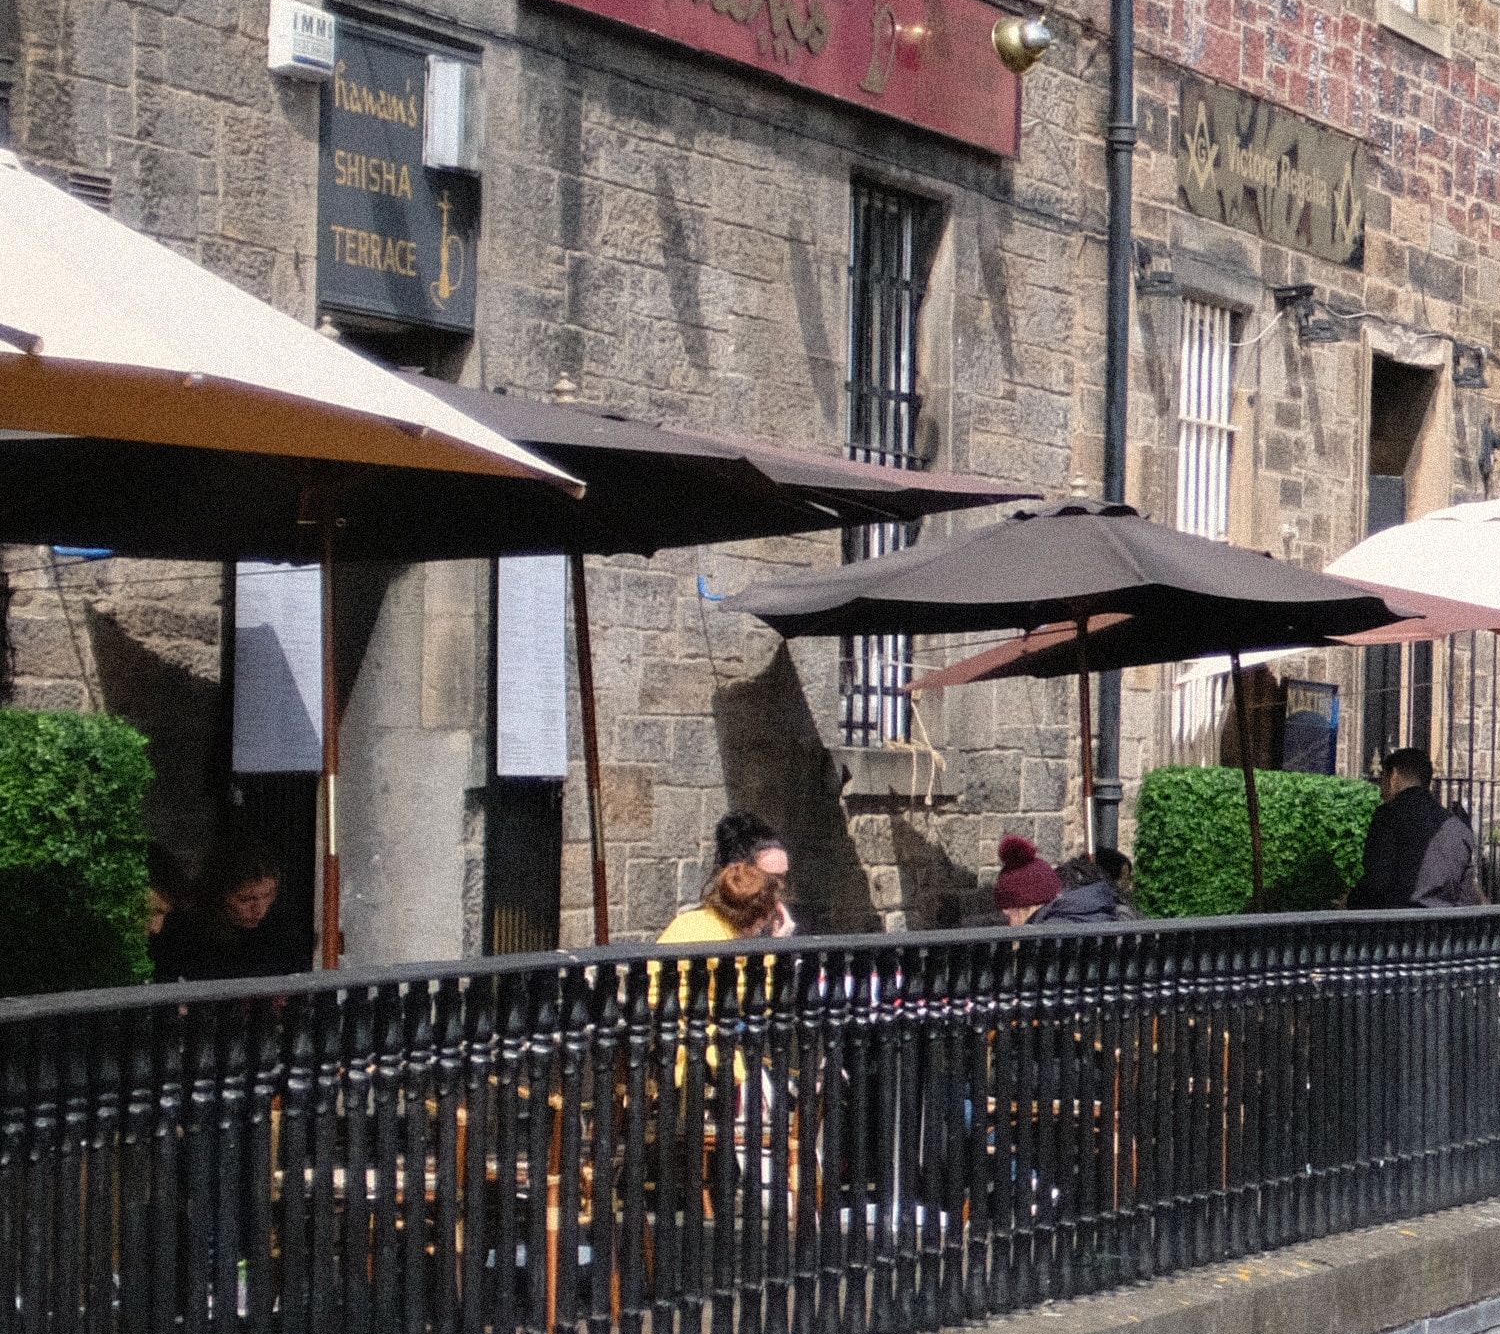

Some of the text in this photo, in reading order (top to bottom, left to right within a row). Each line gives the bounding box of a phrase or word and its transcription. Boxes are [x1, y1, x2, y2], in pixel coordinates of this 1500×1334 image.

[334, 150, 414, 200] SHISHA
[1227, 133, 1277, 188] Victoria
[1281, 153, 1328, 208] Regalia
[331, 224, 418, 277] TERRACE
